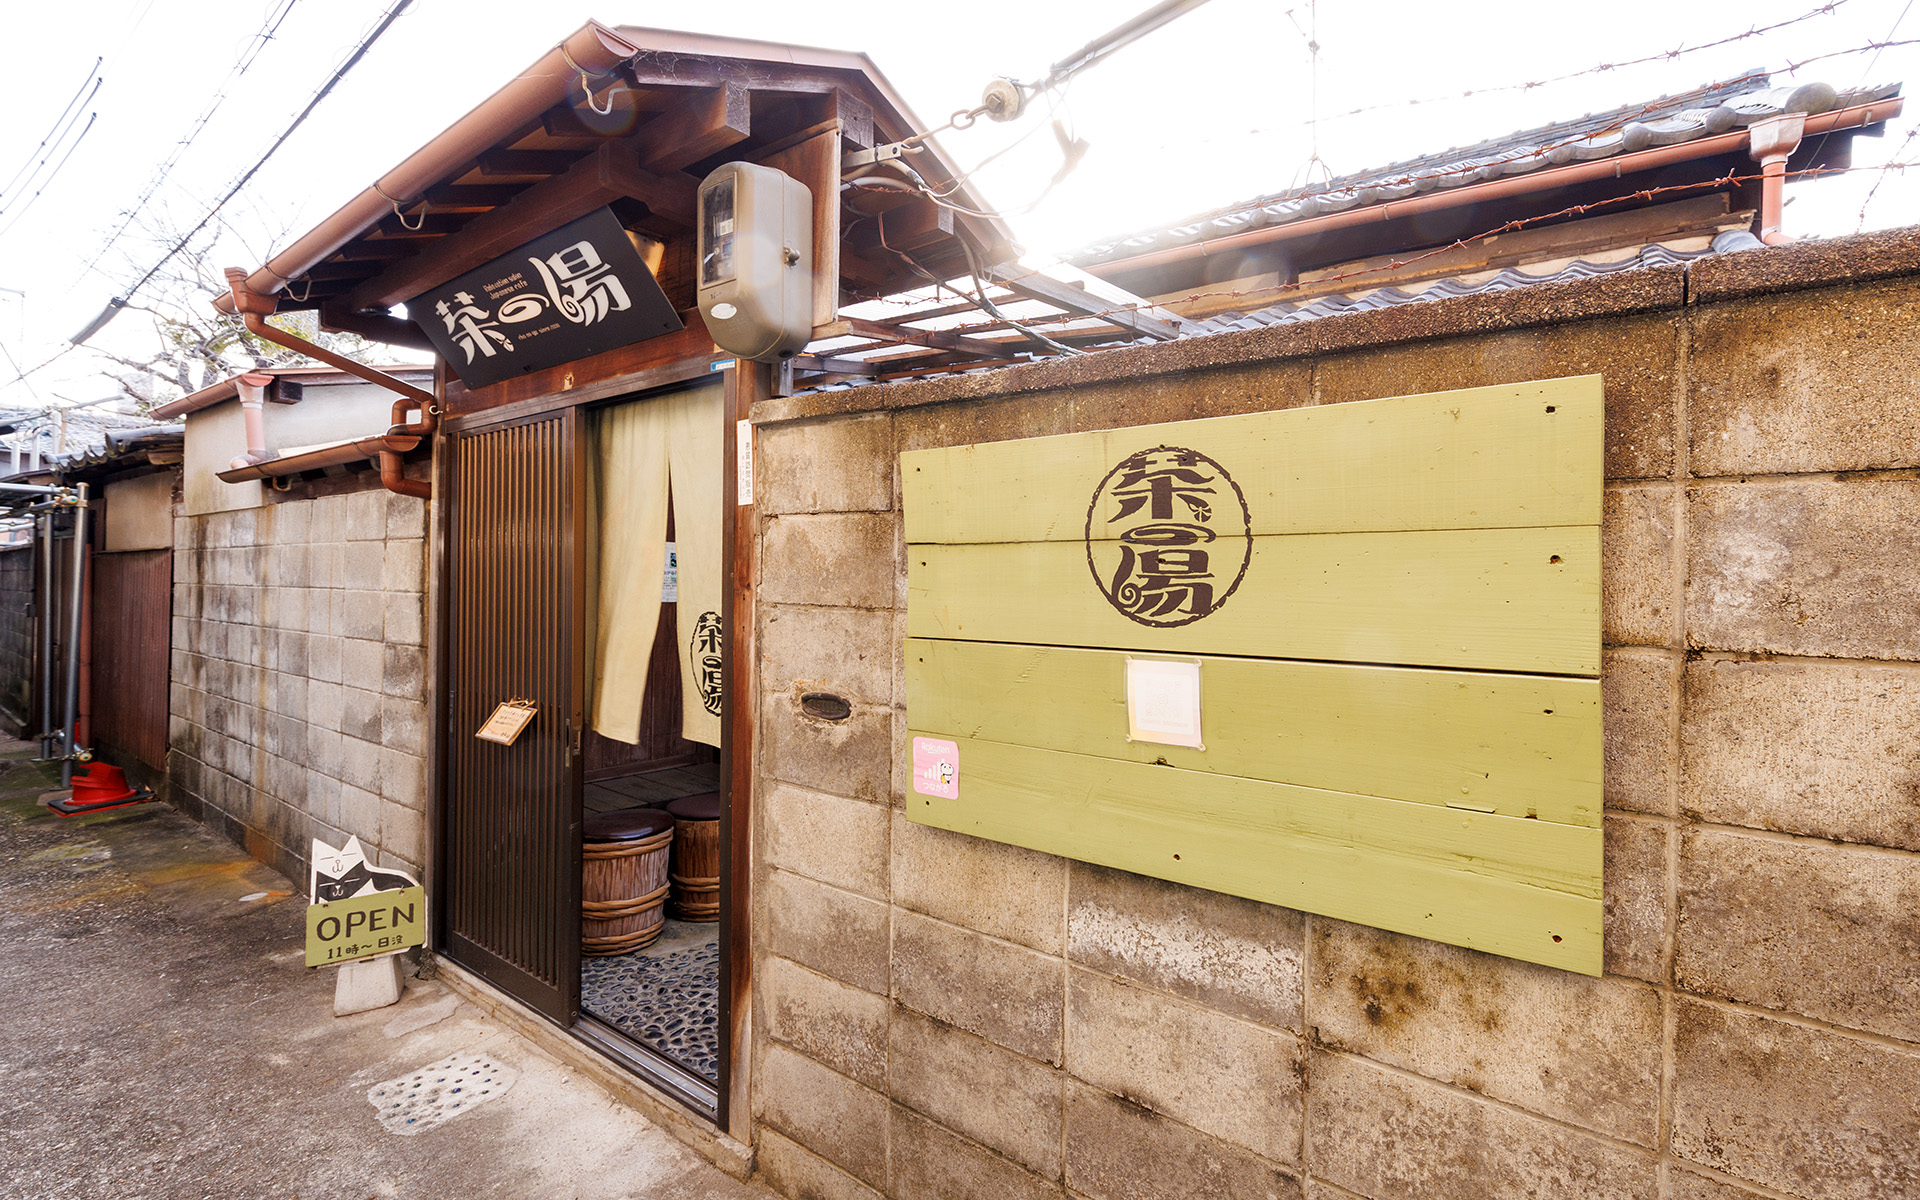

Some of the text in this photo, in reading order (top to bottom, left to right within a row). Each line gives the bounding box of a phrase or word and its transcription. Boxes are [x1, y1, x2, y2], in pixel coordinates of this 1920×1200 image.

[435, 241, 631, 365] 茶の湯
[489, 286, 515, 300] Japanese
[1107, 455, 1217, 617] 茶の湯
[316, 903, 415, 942] OPEN
